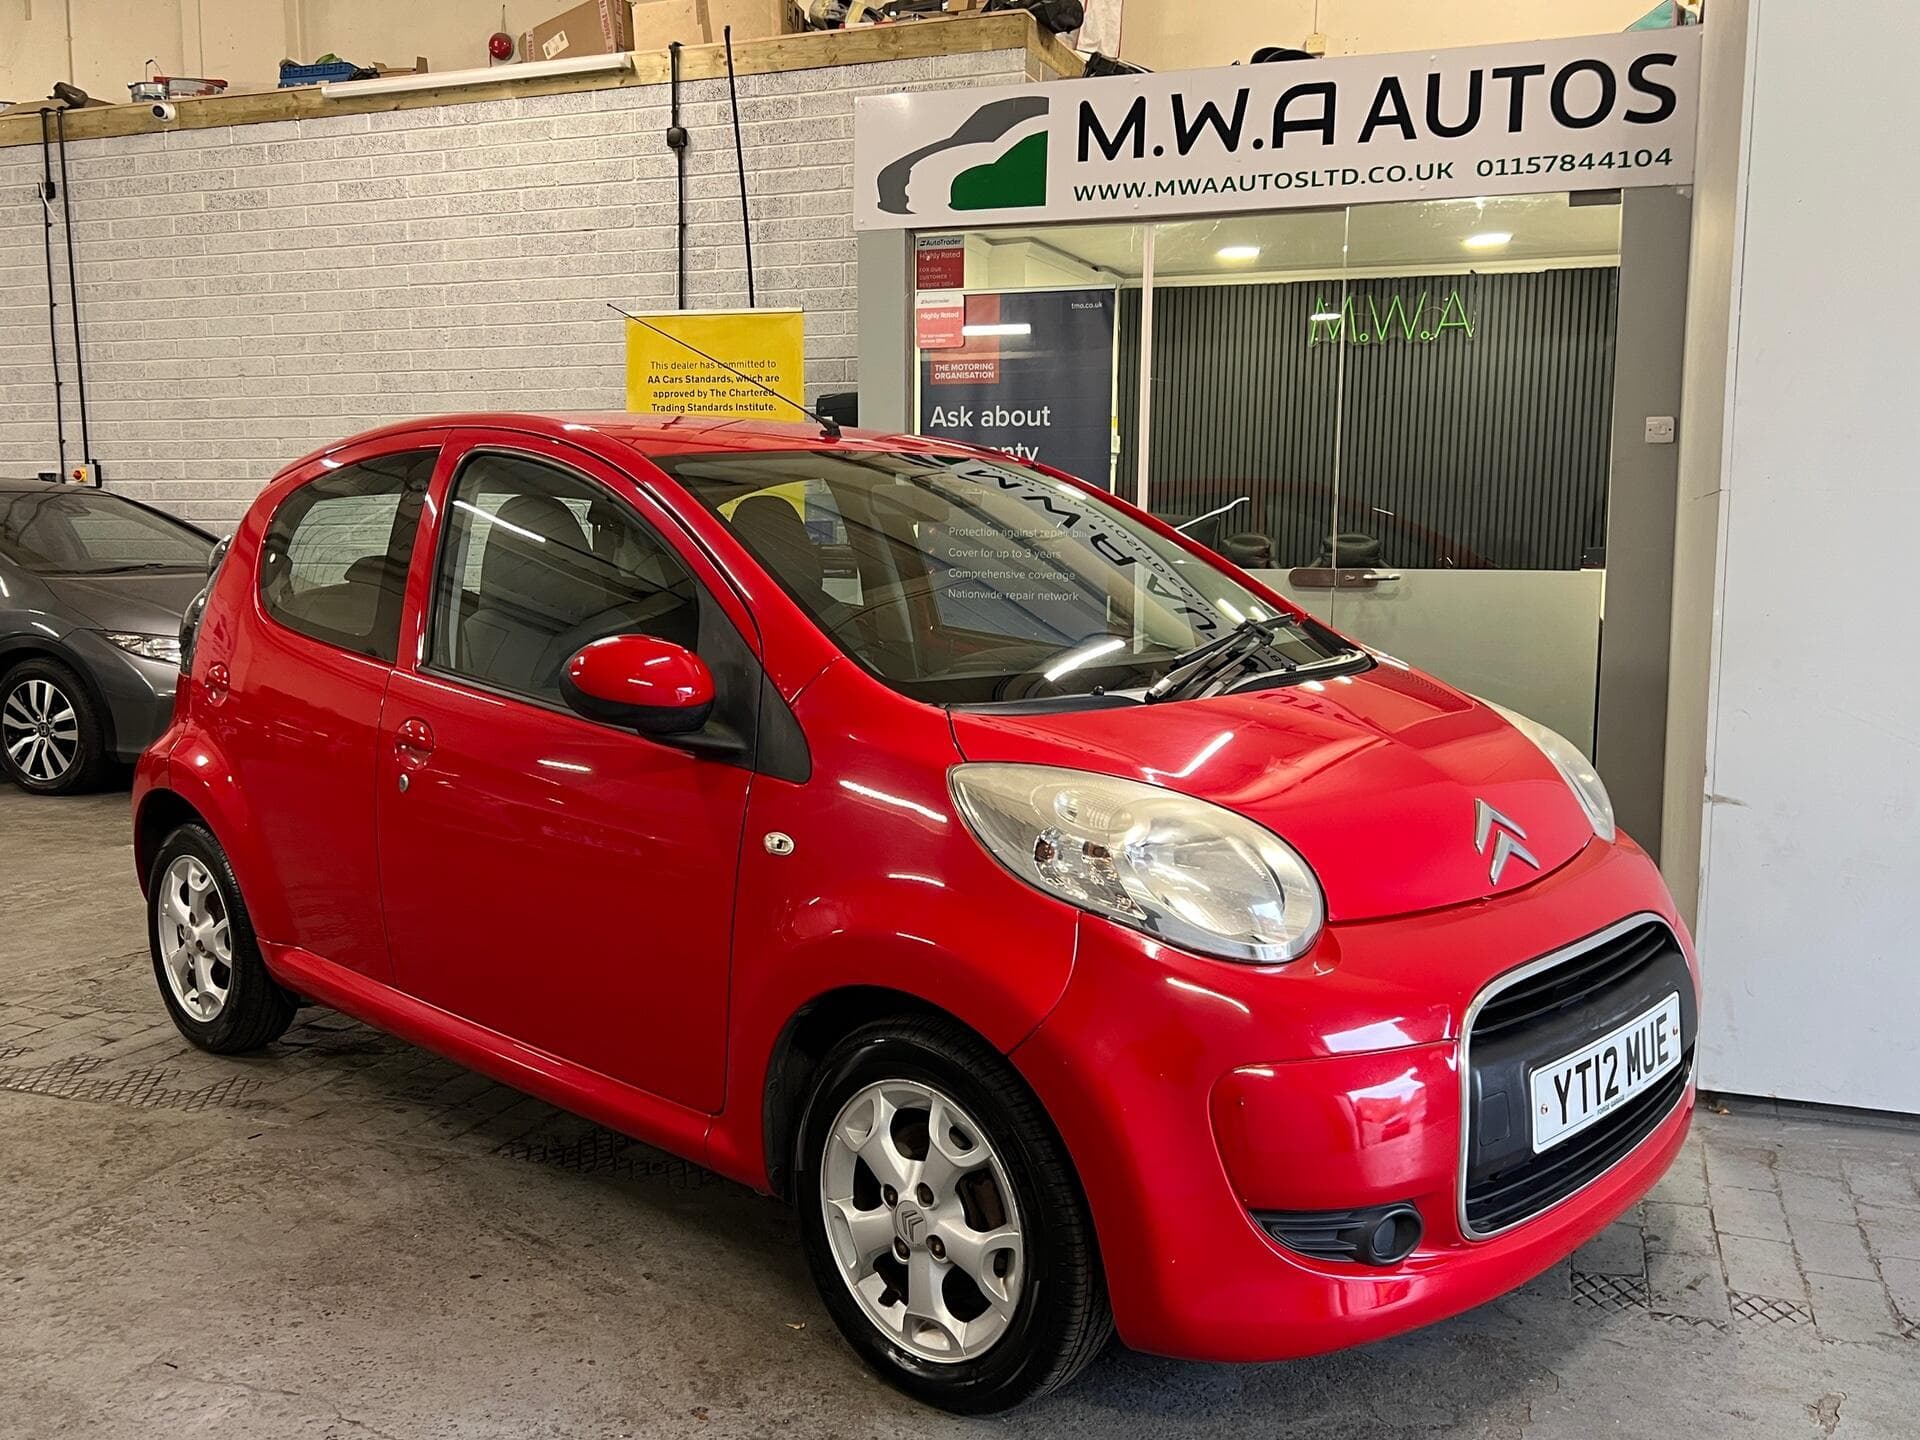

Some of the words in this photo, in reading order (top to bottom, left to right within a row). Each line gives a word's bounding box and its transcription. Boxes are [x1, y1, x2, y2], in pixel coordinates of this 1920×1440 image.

[1077, 80, 1337, 162] M.W.A
[1357, 52, 1678, 143] AUTOS
[1074, 161, 1454, 201] WWW.MWAAUTOSLTD.CO.UK
[1476, 147, 1673, 177] 01157844104
[926, 238, 961, 246] AutoTrader
[941, 251, 961, 259] Rated
[1310, 290, 1473, 344] M.W.A
[651, 361, 669, 370] This
[671, 360, 697, 370] dealer
[700, 361, 715, 369] has
[718, 359, 765, 369] committed
[767, 360, 777, 368] to
[951, 363, 995, 371] MOTORING
[648, 375, 660, 384] AA
[662, 375, 683, 384] Cars
[685, 374, 734, 384] Standards,
[736, 374, 763, 382] which
[935, 371, 995, 380] ORGANISATION
[653, 388, 695, 398] approved
[698, 389, 708, 399] by
[710, 388, 727, 397] The
[729, 388, 775, 397] Chartered
[651, 403, 685, 413] Trading
[687, 403, 733, 412] Standards
[735, 402, 776, 411] Institute.
[930, 405, 973, 428] Ask
[980, 405, 1051, 428] about
[949, 526, 999, 537] Protection
[1001, 527, 1038, 539] against
[948, 547, 978, 558] Cover
[980, 547, 993, 558] for
[996, 550, 1010, 560] up
[1012, 549, 1022, 558] to
[1024, 549, 1032, 558] 3
[1034, 550, 1062, 561] years
[948, 568, 1026, 580] Comprehensive
[1028, 572, 1076, 583] coverage
[948, 588, 1002, 600] Nationwide
[1006, 591, 1034, 601] repair
[1037, 591, 1079, 601] network
[1553, 1045, 1619, 1125] YT12
[1626, 1012, 1669, 1087] MUE
